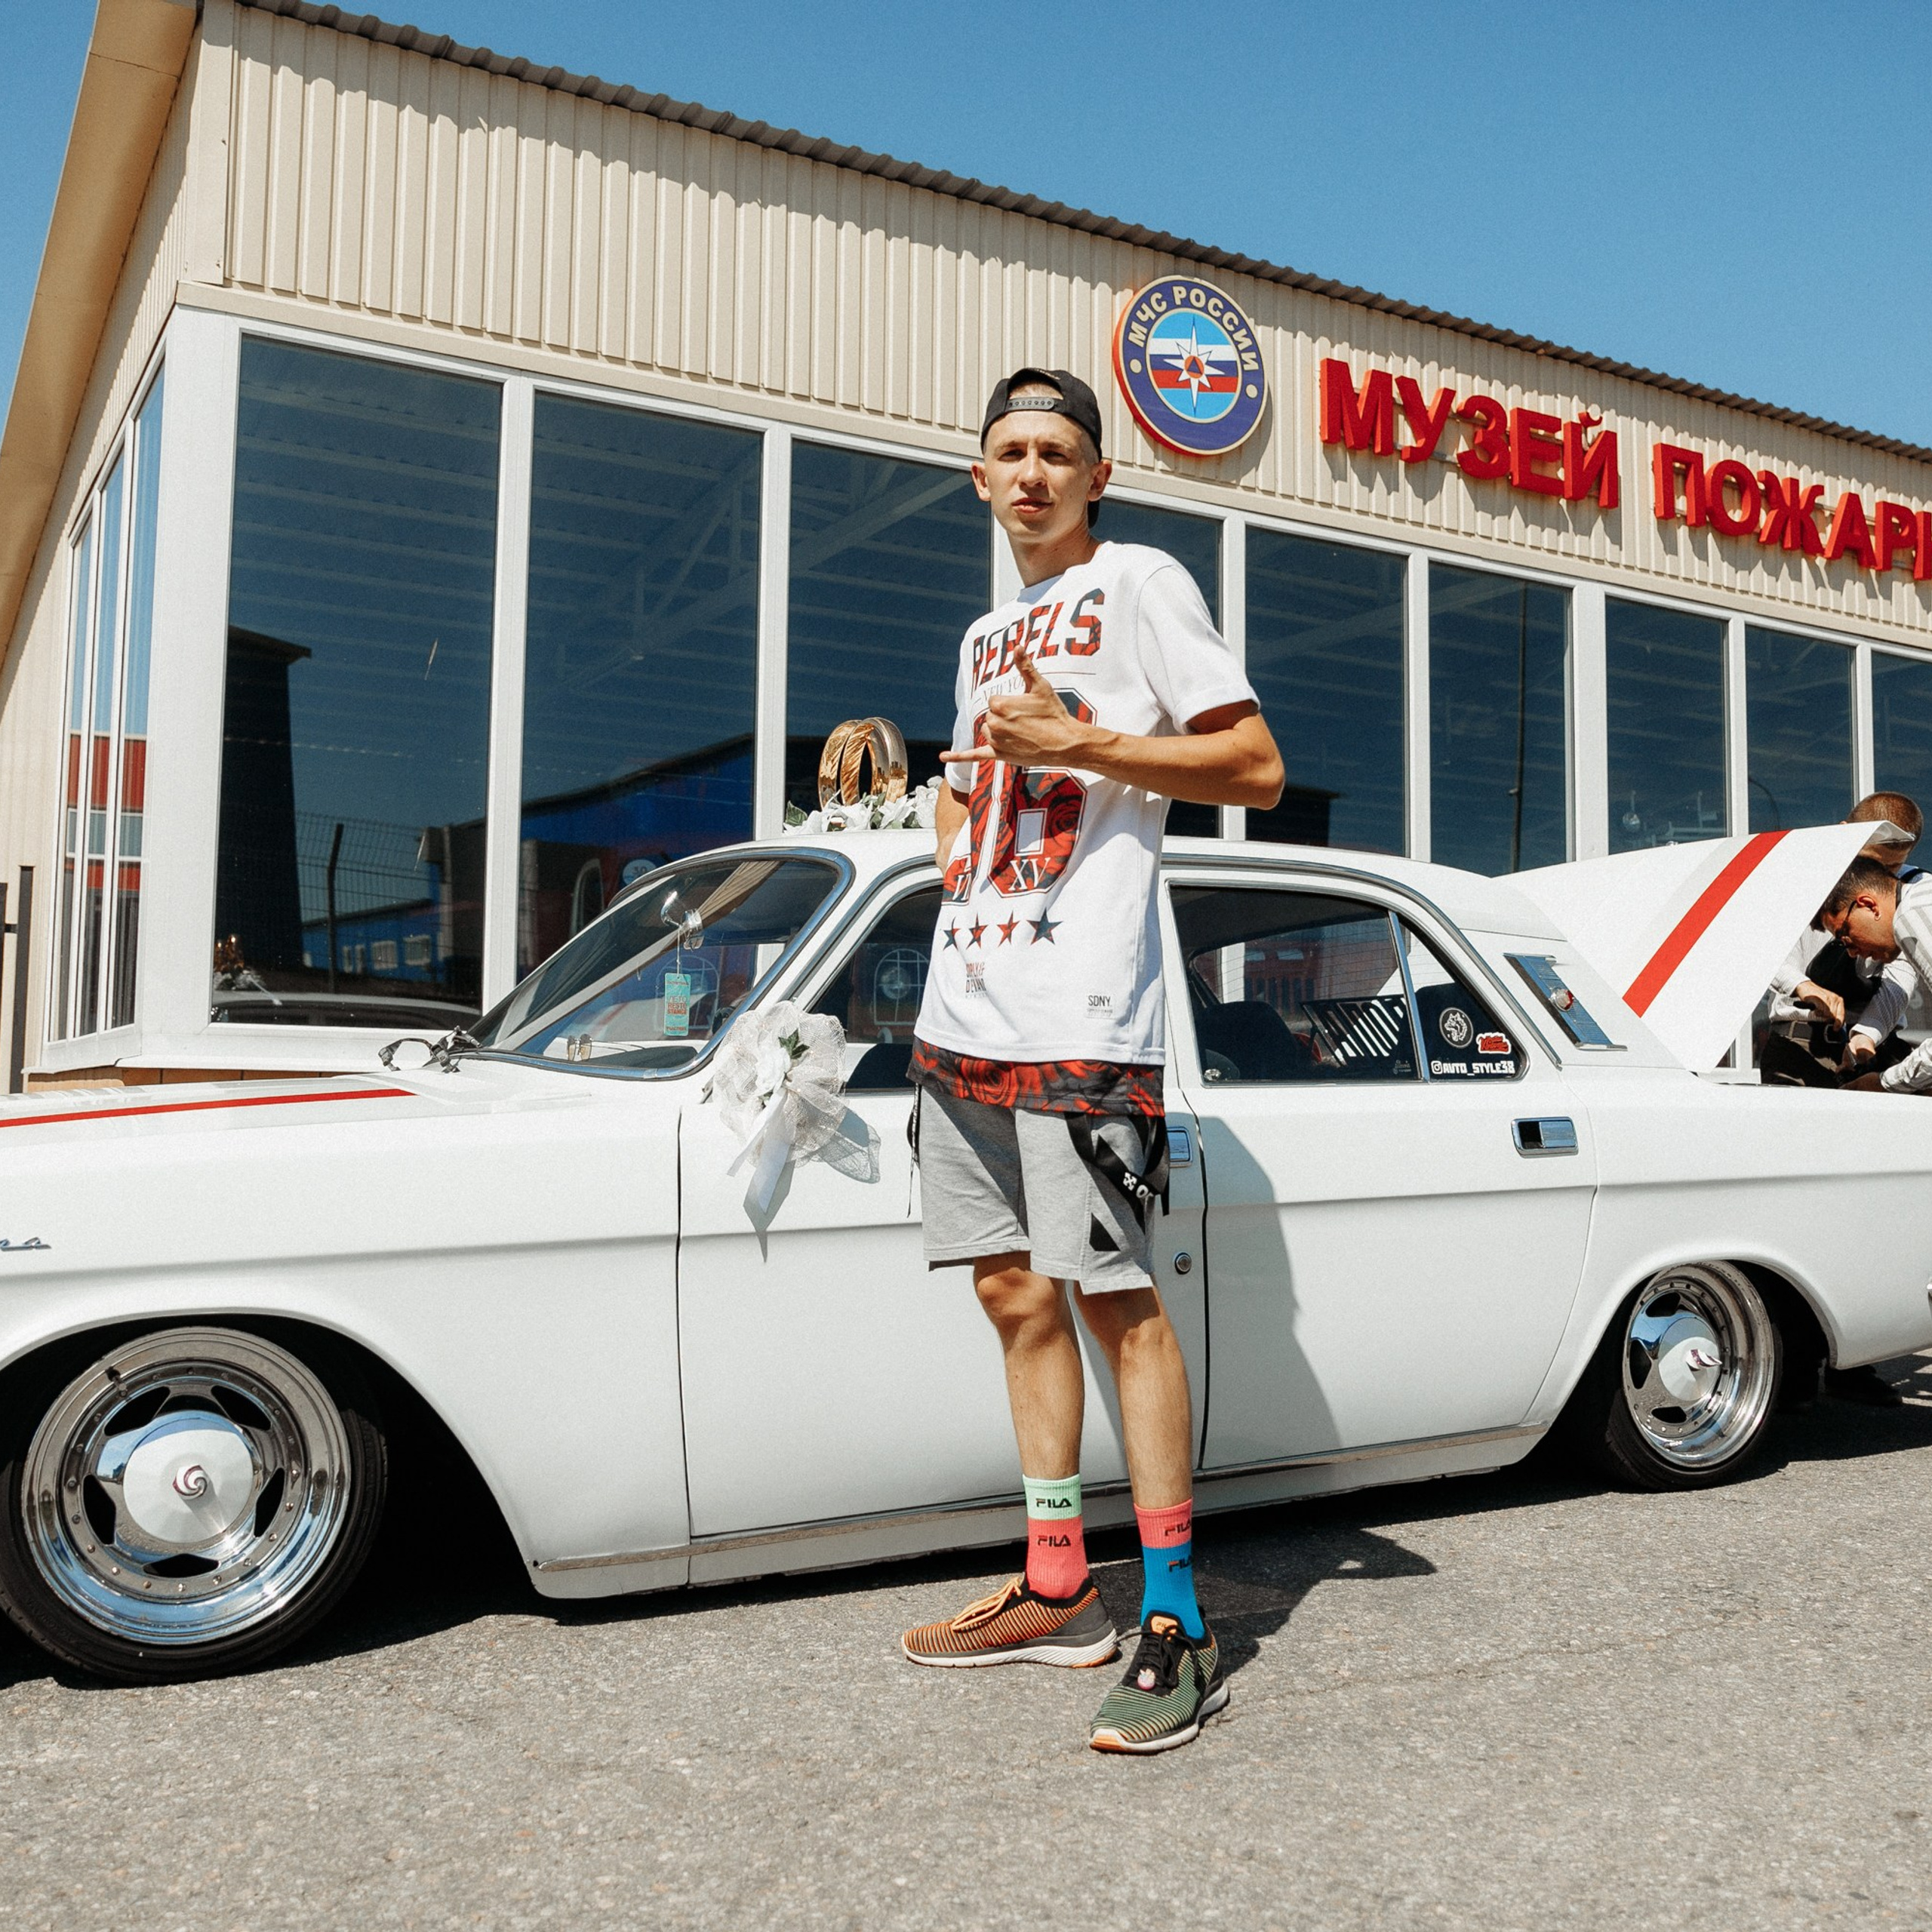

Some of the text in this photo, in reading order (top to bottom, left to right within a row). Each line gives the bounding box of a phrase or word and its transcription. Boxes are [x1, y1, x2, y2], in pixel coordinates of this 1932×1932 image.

[1128, 286, 1259, 371] МЧС РОССИИ
[1320, 358, 1619, 509] МУЗЕЙ
[971, 588, 1105, 700] REBELS
[1004, 674, 1025, 693] YO
[1008, 857, 1051, 892] XV
[1036, 1498, 1072, 1508] FILA
[1038, 1534, 1071, 1547] FILA
